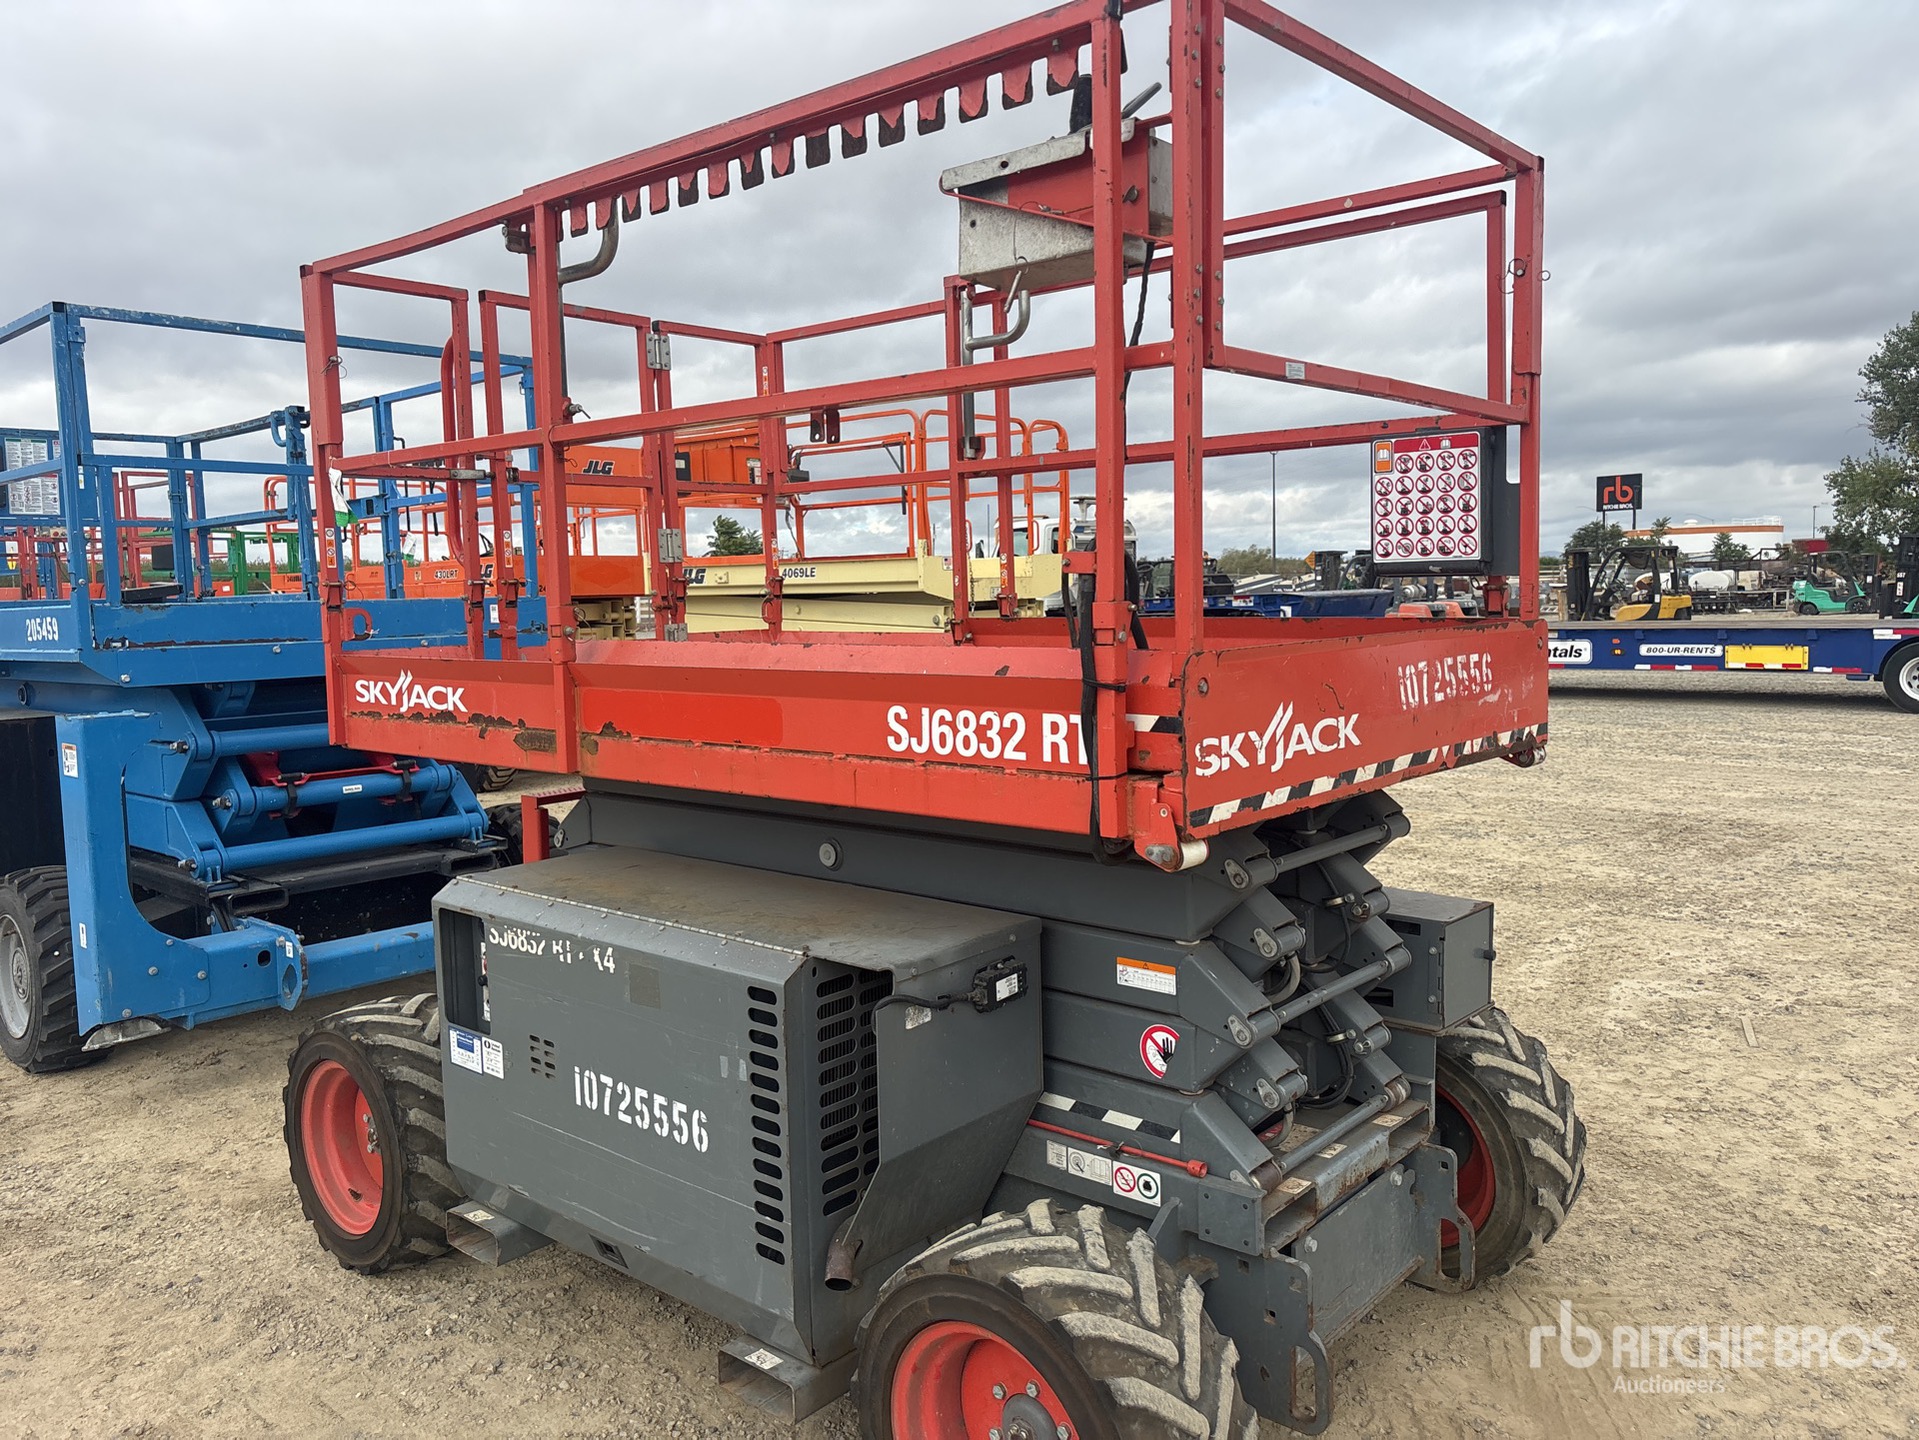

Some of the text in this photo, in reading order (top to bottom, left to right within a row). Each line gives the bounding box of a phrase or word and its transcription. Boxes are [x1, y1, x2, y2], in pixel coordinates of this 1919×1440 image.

[583, 460, 614, 475] JLG
[434, 570, 459, 579] 430LRT
[480, 564, 494, 579] LG
[782, 567, 816, 578] 4069LE
[26, 617, 59, 642] 205459
[1646, 646, 1716, 655] 800-UR-RENTS
[355, 669, 469, 713] SKYJACK
[886, 704, 1027, 761] SJ6832
[1195, 701, 1362, 777] SKYJACK
